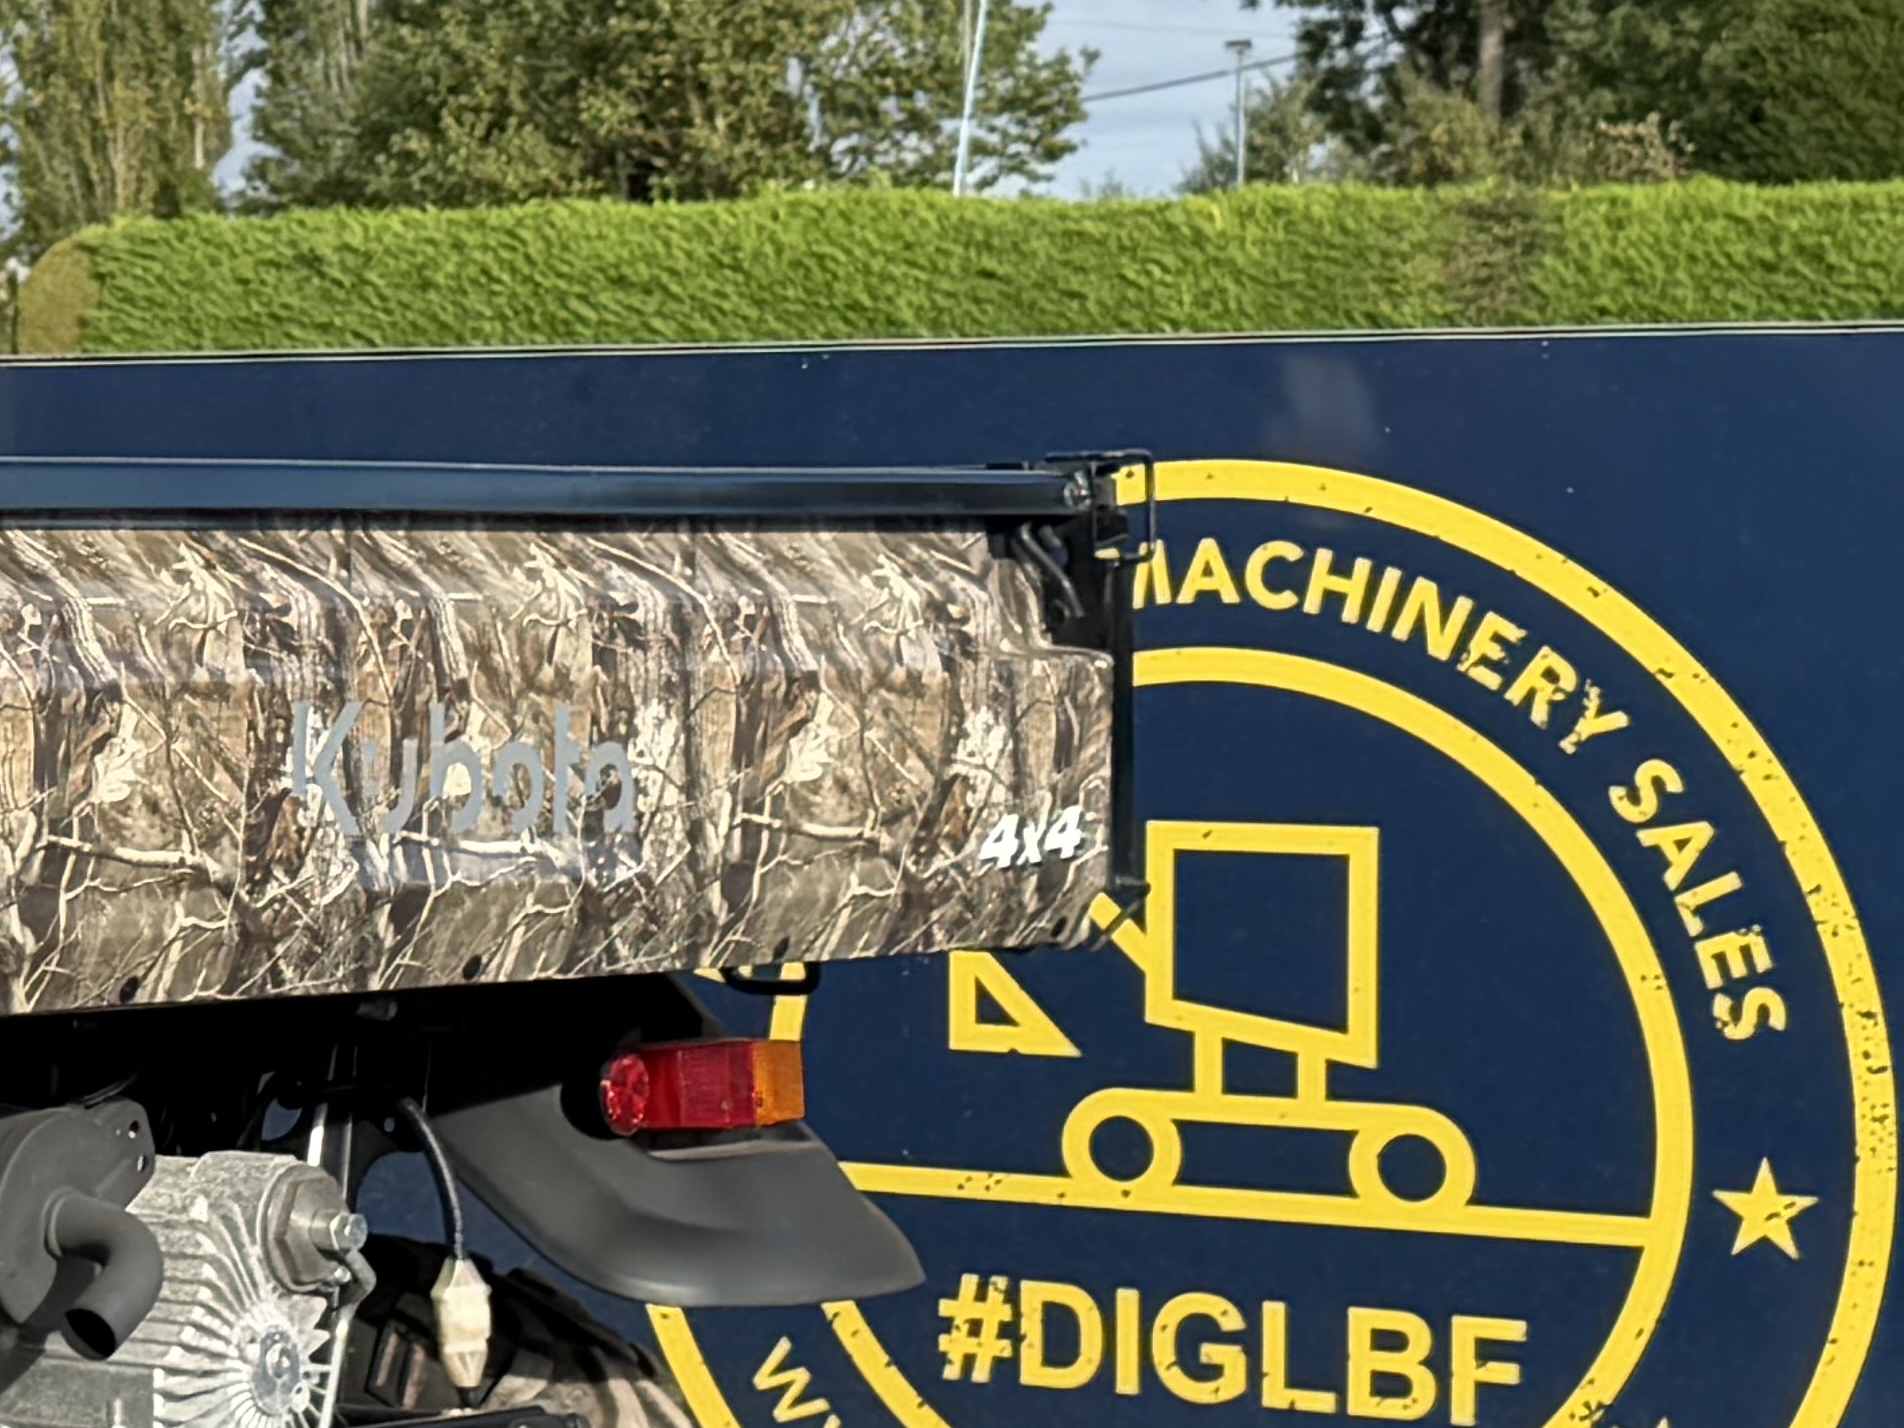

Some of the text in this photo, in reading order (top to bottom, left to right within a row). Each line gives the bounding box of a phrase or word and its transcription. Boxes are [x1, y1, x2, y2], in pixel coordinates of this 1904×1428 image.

[291, 699, 636, 837] Kubota
[978, 804, 1084, 868] 4x4
[1608, 758, 1787, 1041] SALES
[937, 1272, 1528, 1427] #DIGLBF
